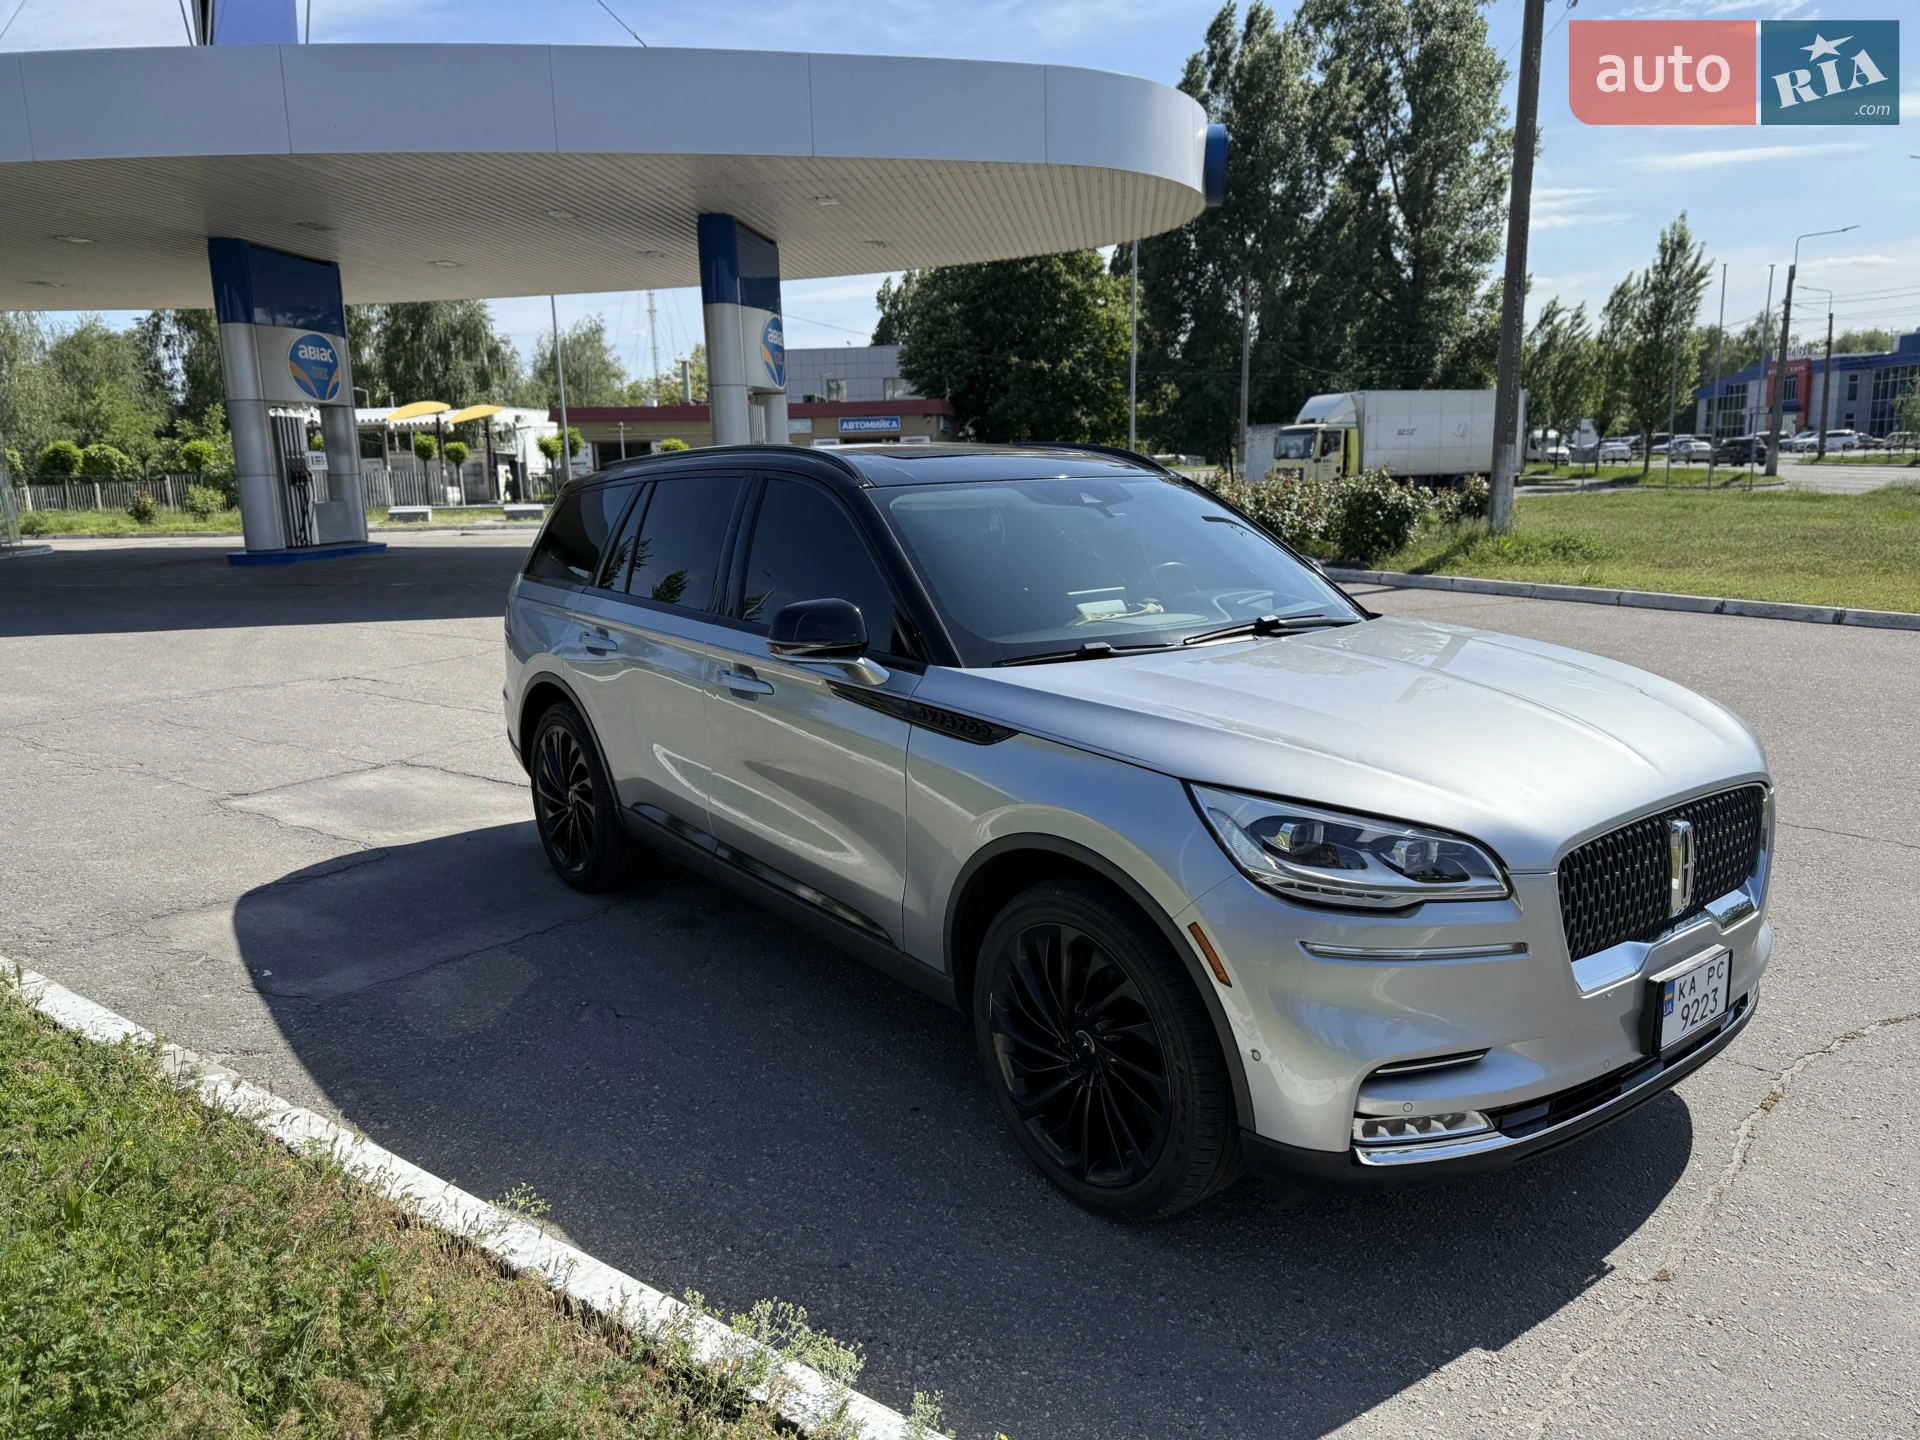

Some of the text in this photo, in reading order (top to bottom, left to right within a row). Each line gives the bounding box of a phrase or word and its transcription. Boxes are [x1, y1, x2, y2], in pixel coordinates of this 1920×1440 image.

[841, 418, 898, 430] АВТОМИЙКА
[1678, 975, 1696, 1002] KA
[1663, 1002, 1672, 1015] UA
[1681, 986, 1719, 1032] 9223
